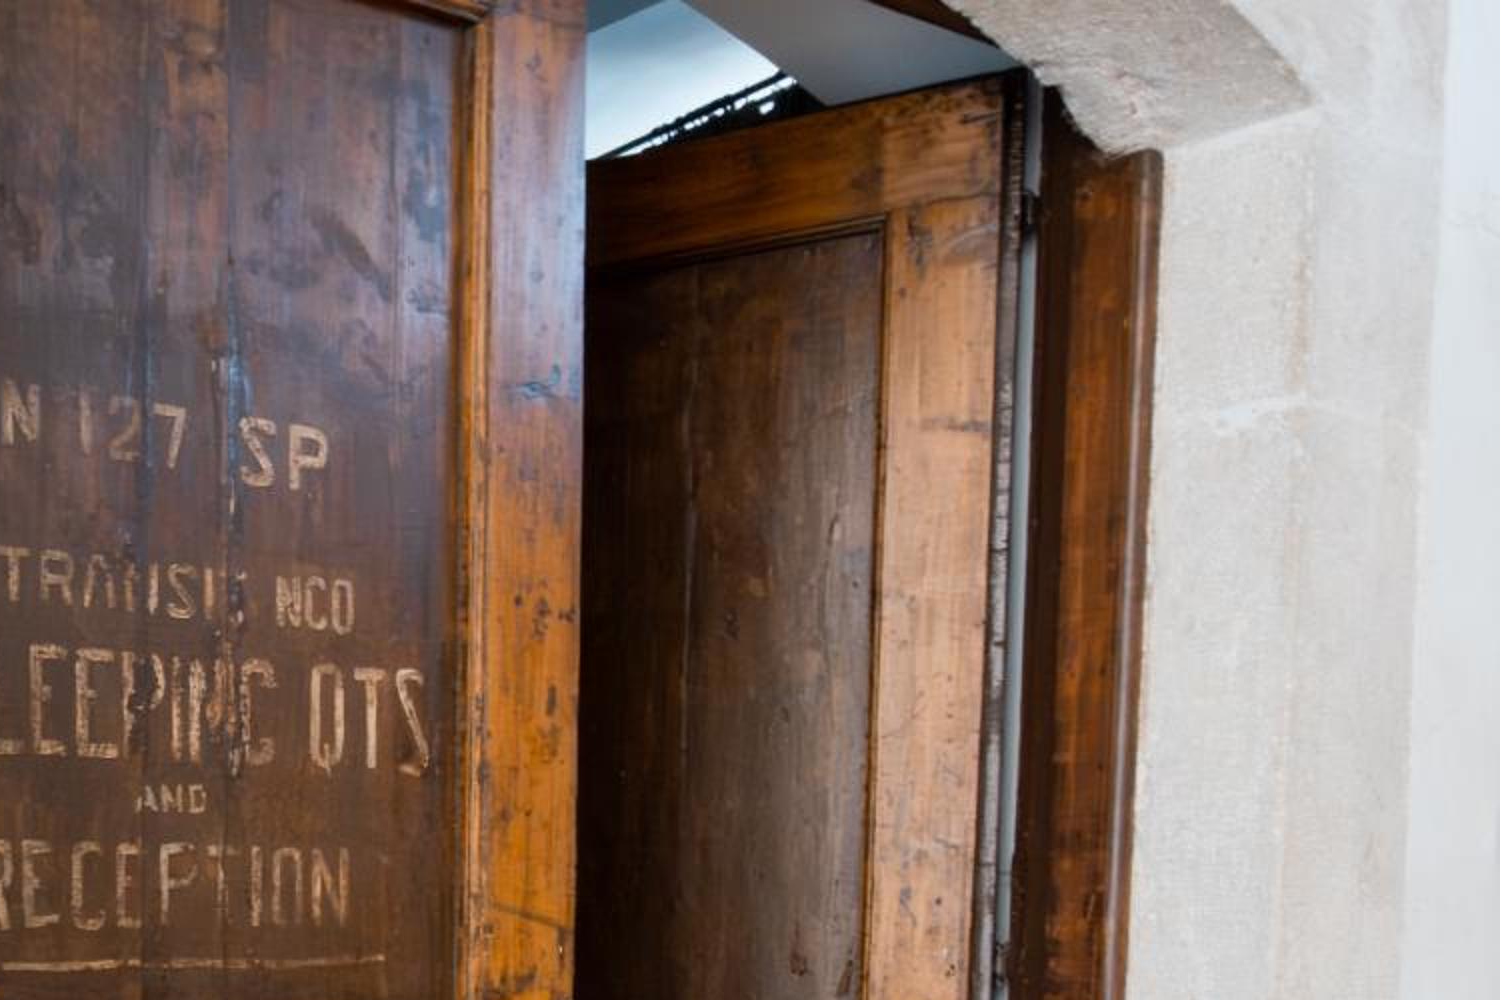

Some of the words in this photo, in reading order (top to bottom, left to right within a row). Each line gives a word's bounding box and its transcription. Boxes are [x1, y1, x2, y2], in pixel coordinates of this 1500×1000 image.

[2, 379, 40, 447] N
[77, 386, 187, 469] 127
[238, 416, 329, 490] SP
[275, 575, 356, 636] NCO
[308, 664, 430, 778] QTS
[135, 783, 207, 814] AND
